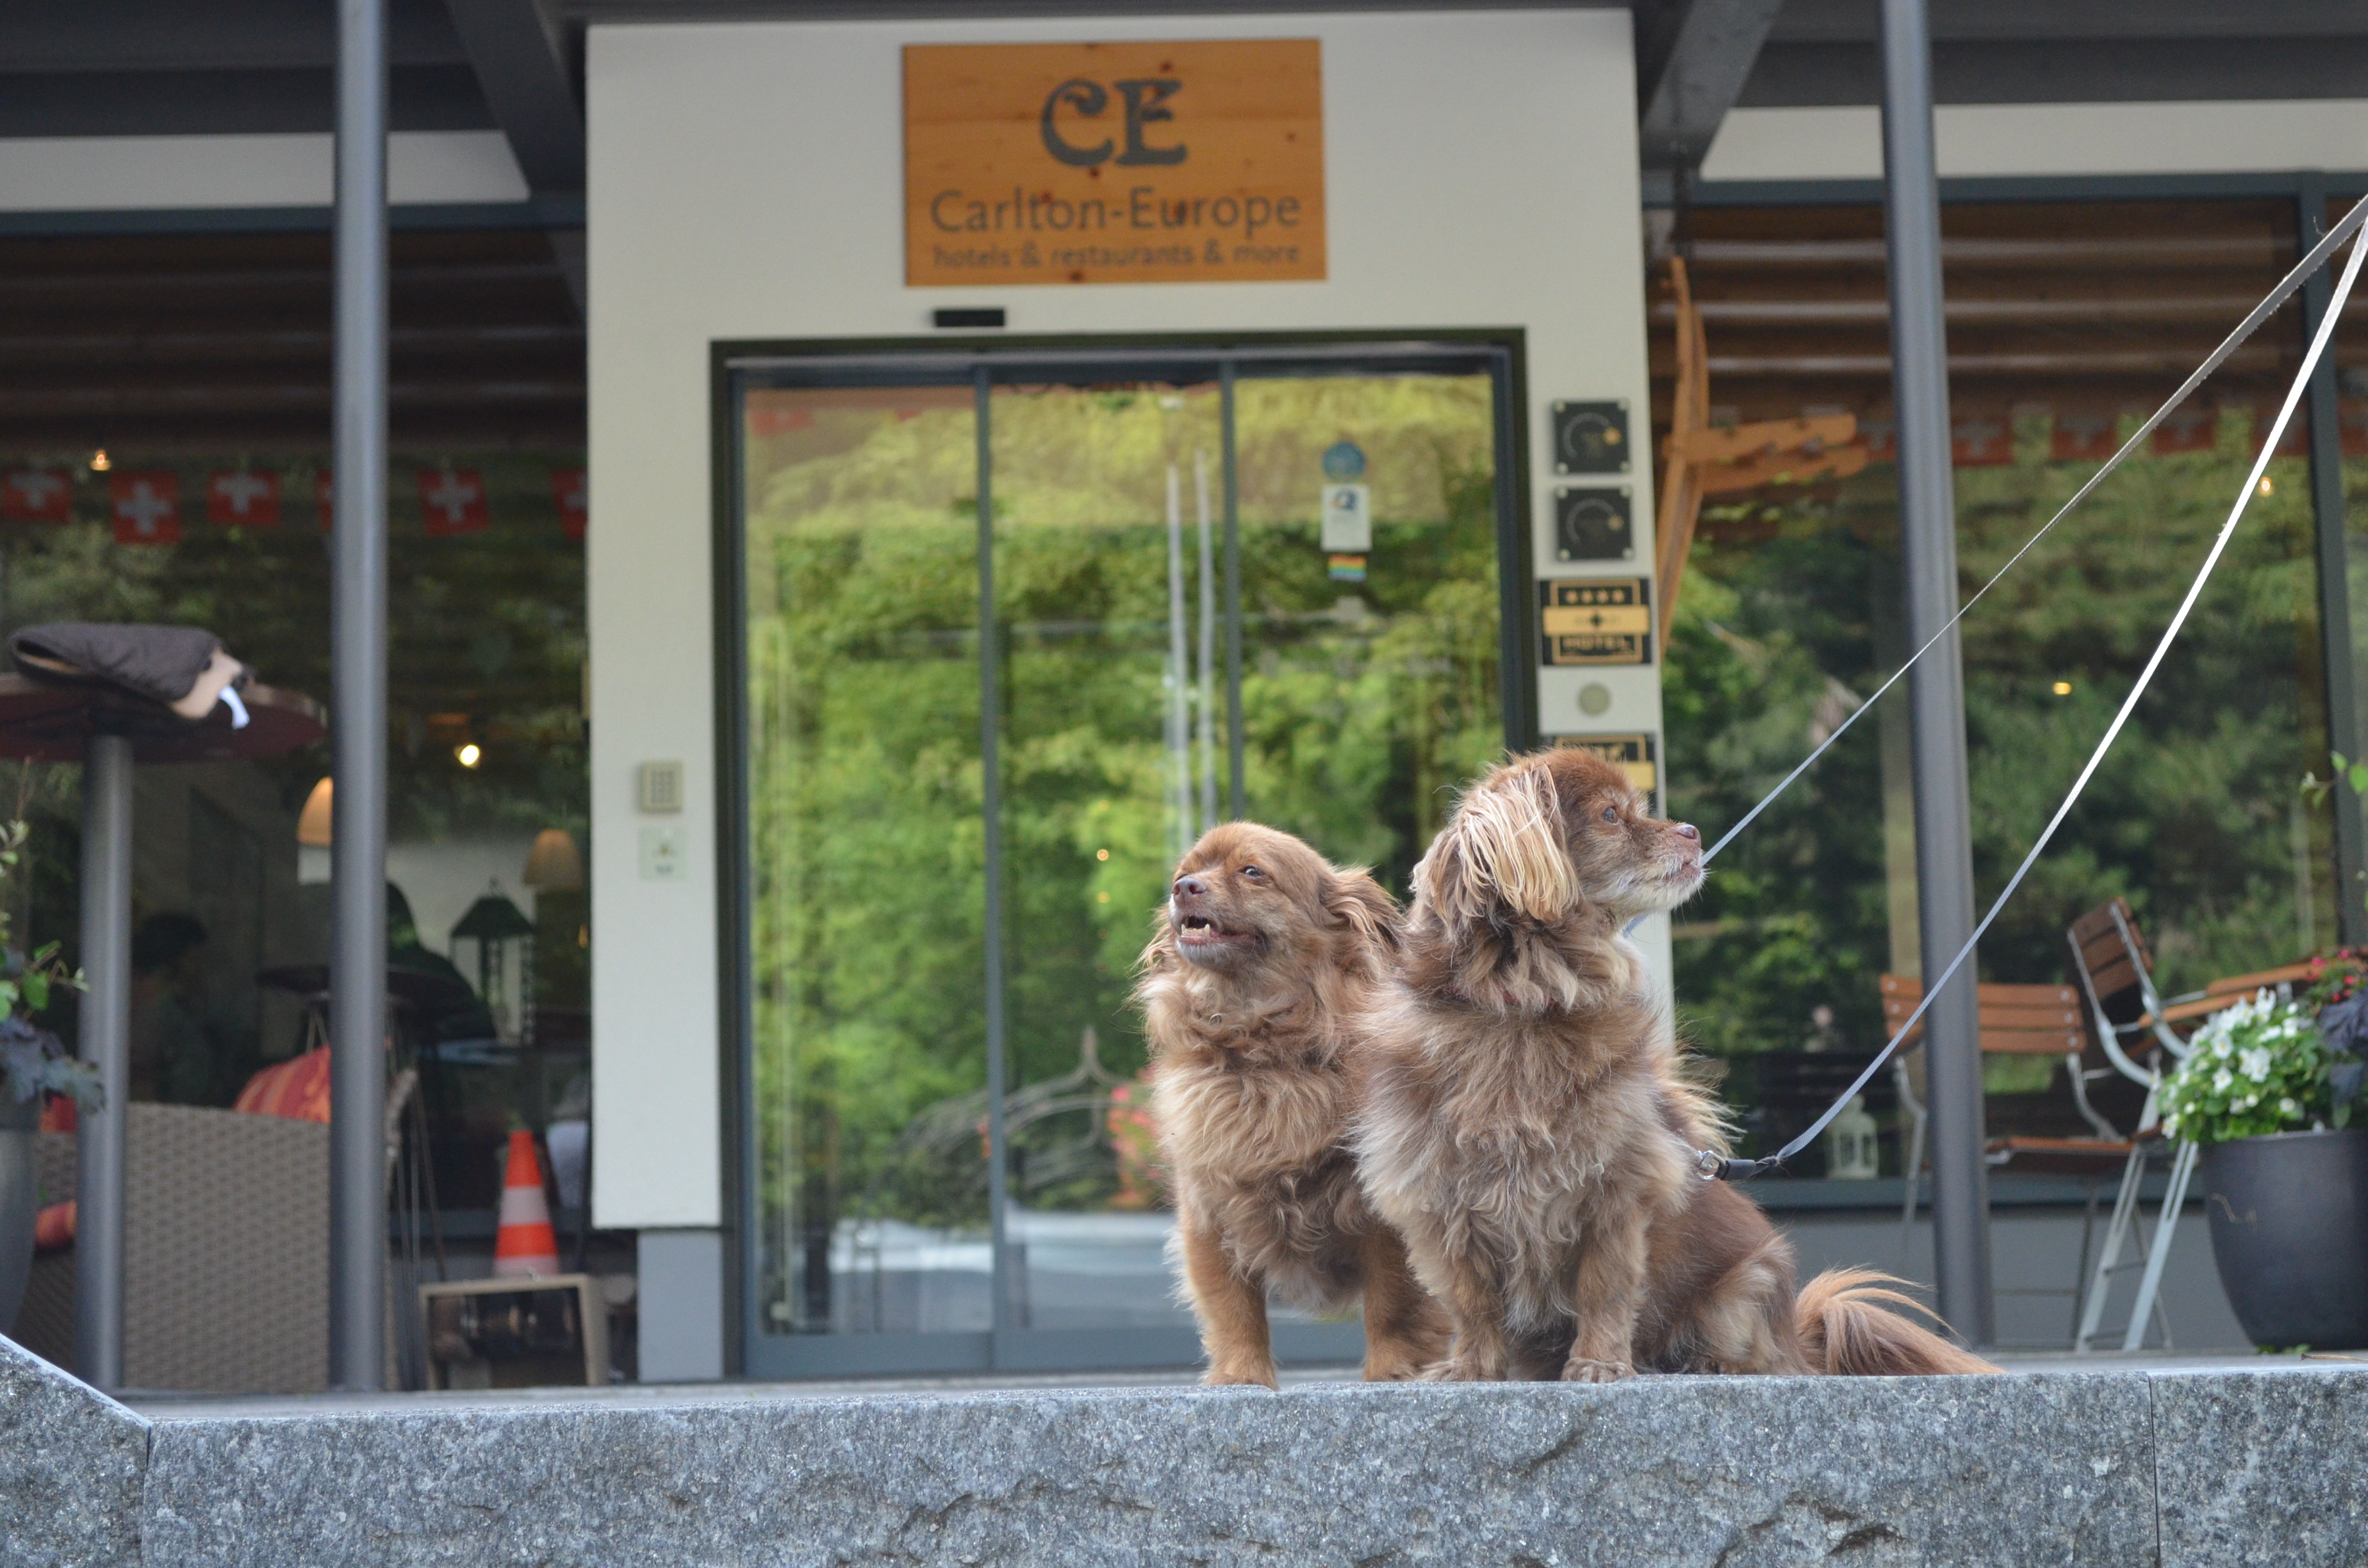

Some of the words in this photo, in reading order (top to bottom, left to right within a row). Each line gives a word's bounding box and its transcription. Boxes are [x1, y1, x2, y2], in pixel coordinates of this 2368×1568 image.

[1040, 78, 1188, 167] CE
[930, 186, 1301, 240] Carlton-Europe
[933, 243, 1011, 268] hotels
[1023, 240, 1040, 267] &
[1050, 243, 1196, 266] restaurants
[1204, 238, 1223, 265] &
[1234, 245, 1300, 265] more
